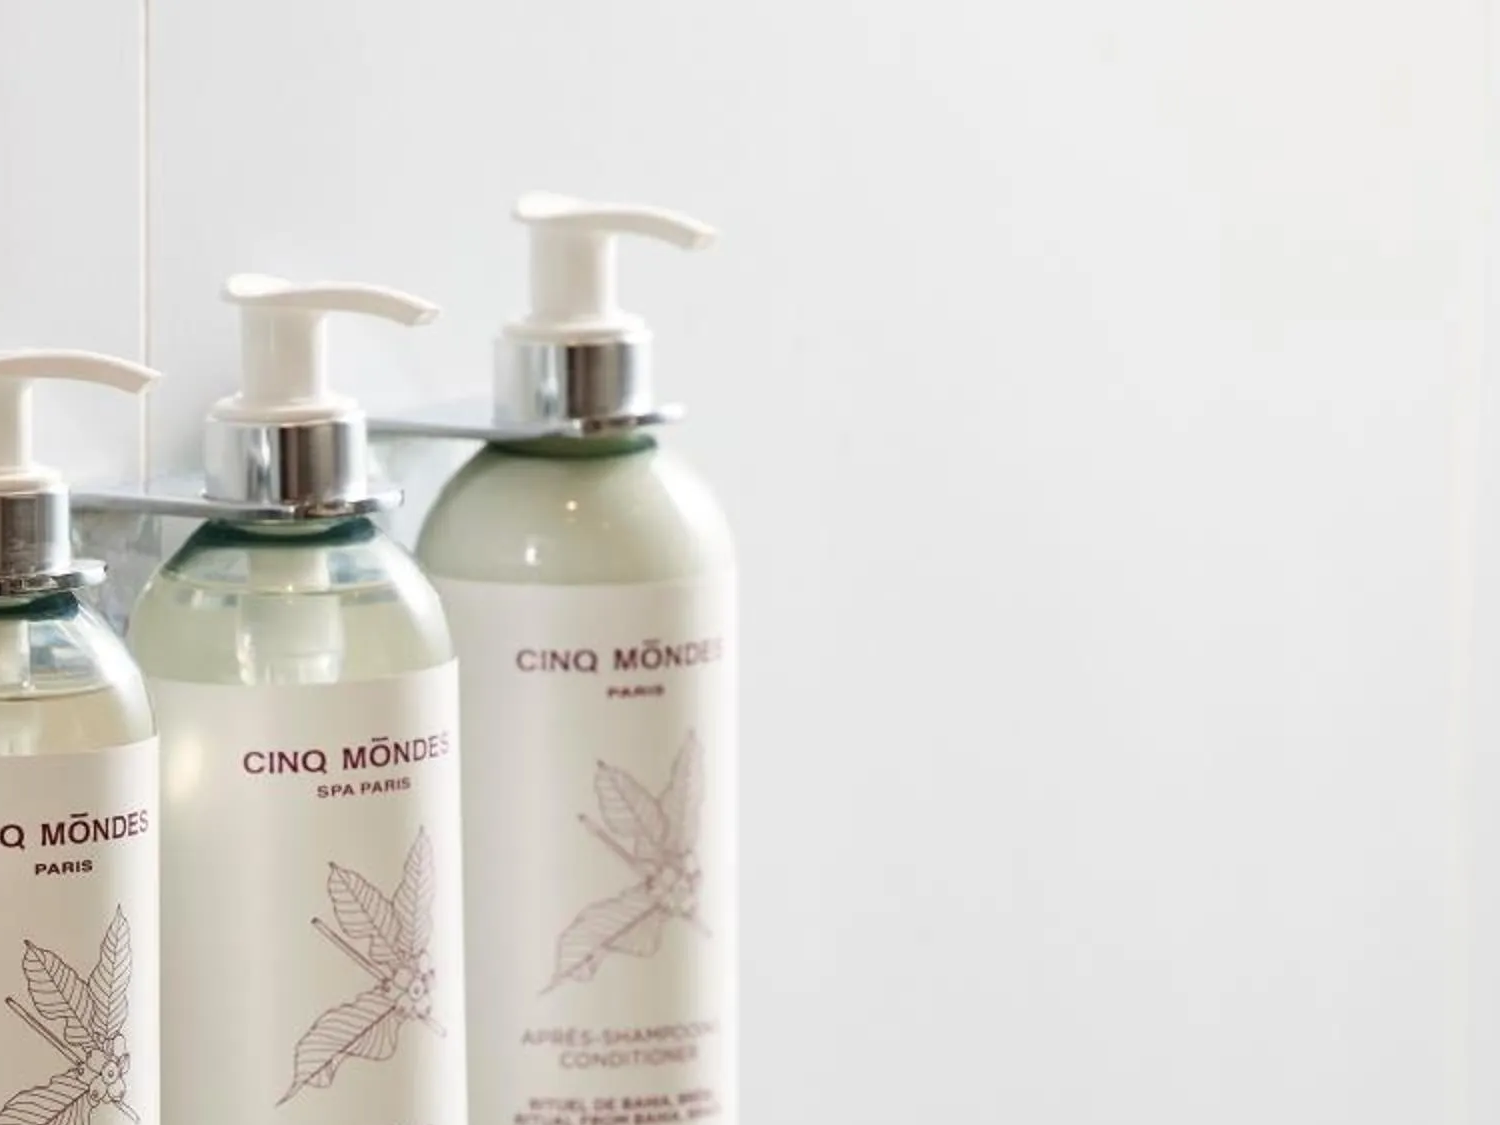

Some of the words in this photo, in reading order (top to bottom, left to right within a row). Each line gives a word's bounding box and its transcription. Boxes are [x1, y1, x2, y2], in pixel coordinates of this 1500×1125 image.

[516, 649, 598, 673] CINQ
[243, 749, 328, 774] CINQ
[317, 783, 355, 799] SPA
[360, 777, 411, 795] PARIS
[35, 859, 93, 876] PARIS
